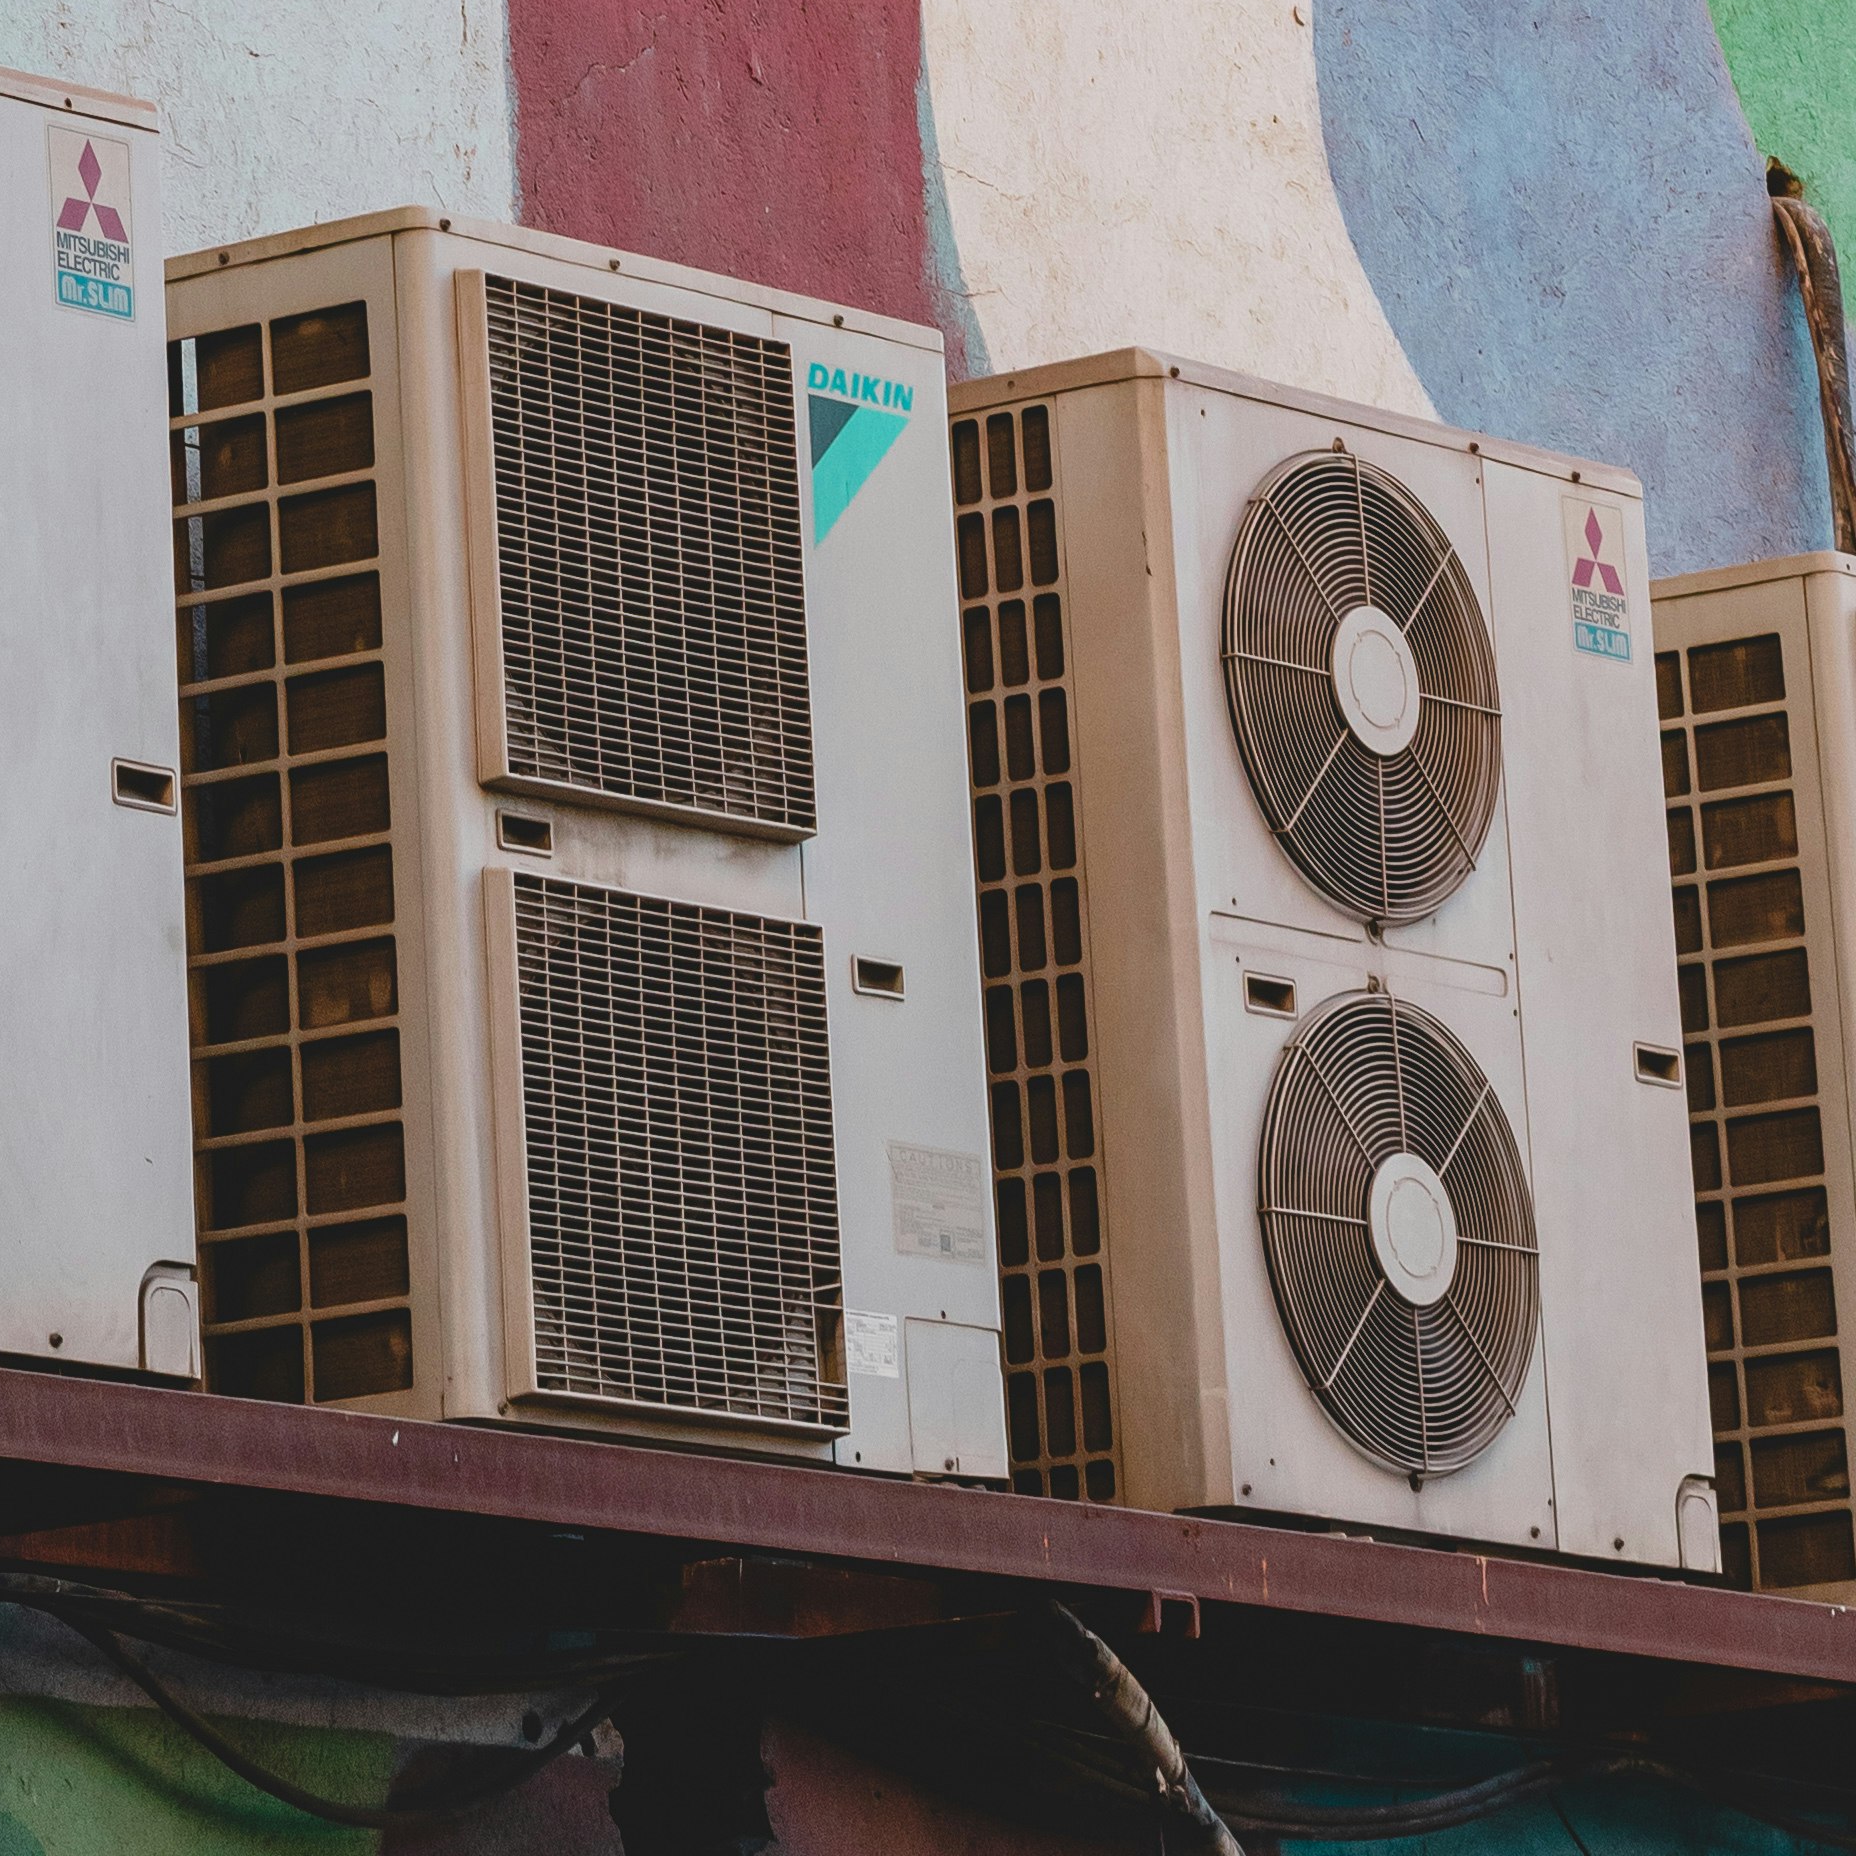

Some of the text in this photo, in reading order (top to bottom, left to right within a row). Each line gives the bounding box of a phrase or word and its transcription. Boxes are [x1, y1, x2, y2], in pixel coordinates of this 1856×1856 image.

[56, 230, 130, 264] MITSUBISHI
[57, 250, 120, 281] ELECTRIC
[807, 361, 913, 412] DAIKIN
[1572, 588, 1626, 614] MITSUBISHI
[1573, 604, 1620, 629] ELECTRIC
